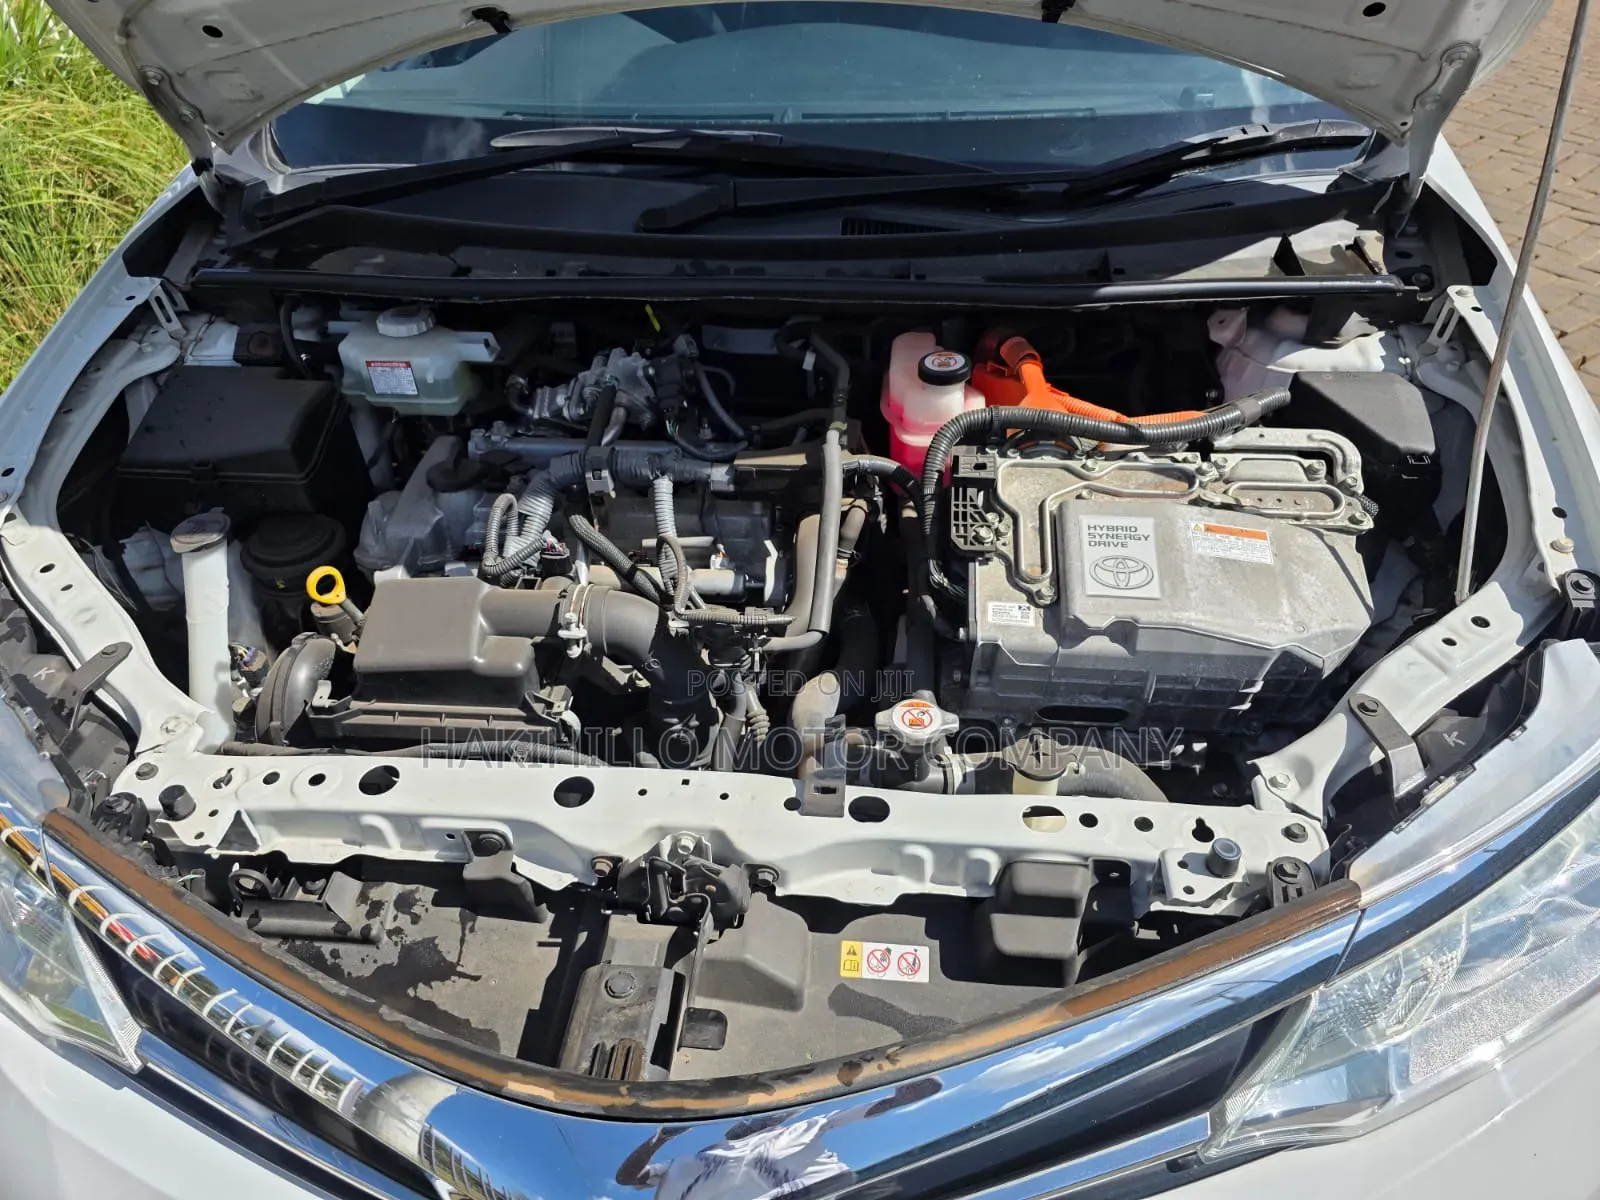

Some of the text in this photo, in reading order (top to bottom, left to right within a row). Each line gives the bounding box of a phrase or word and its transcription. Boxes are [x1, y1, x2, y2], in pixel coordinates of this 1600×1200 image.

[1087, 524, 1138, 533] HYBRID
[1087, 532, 1151, 542] SYNERGY
[1088, 540, 1129, 548] DRIVE
